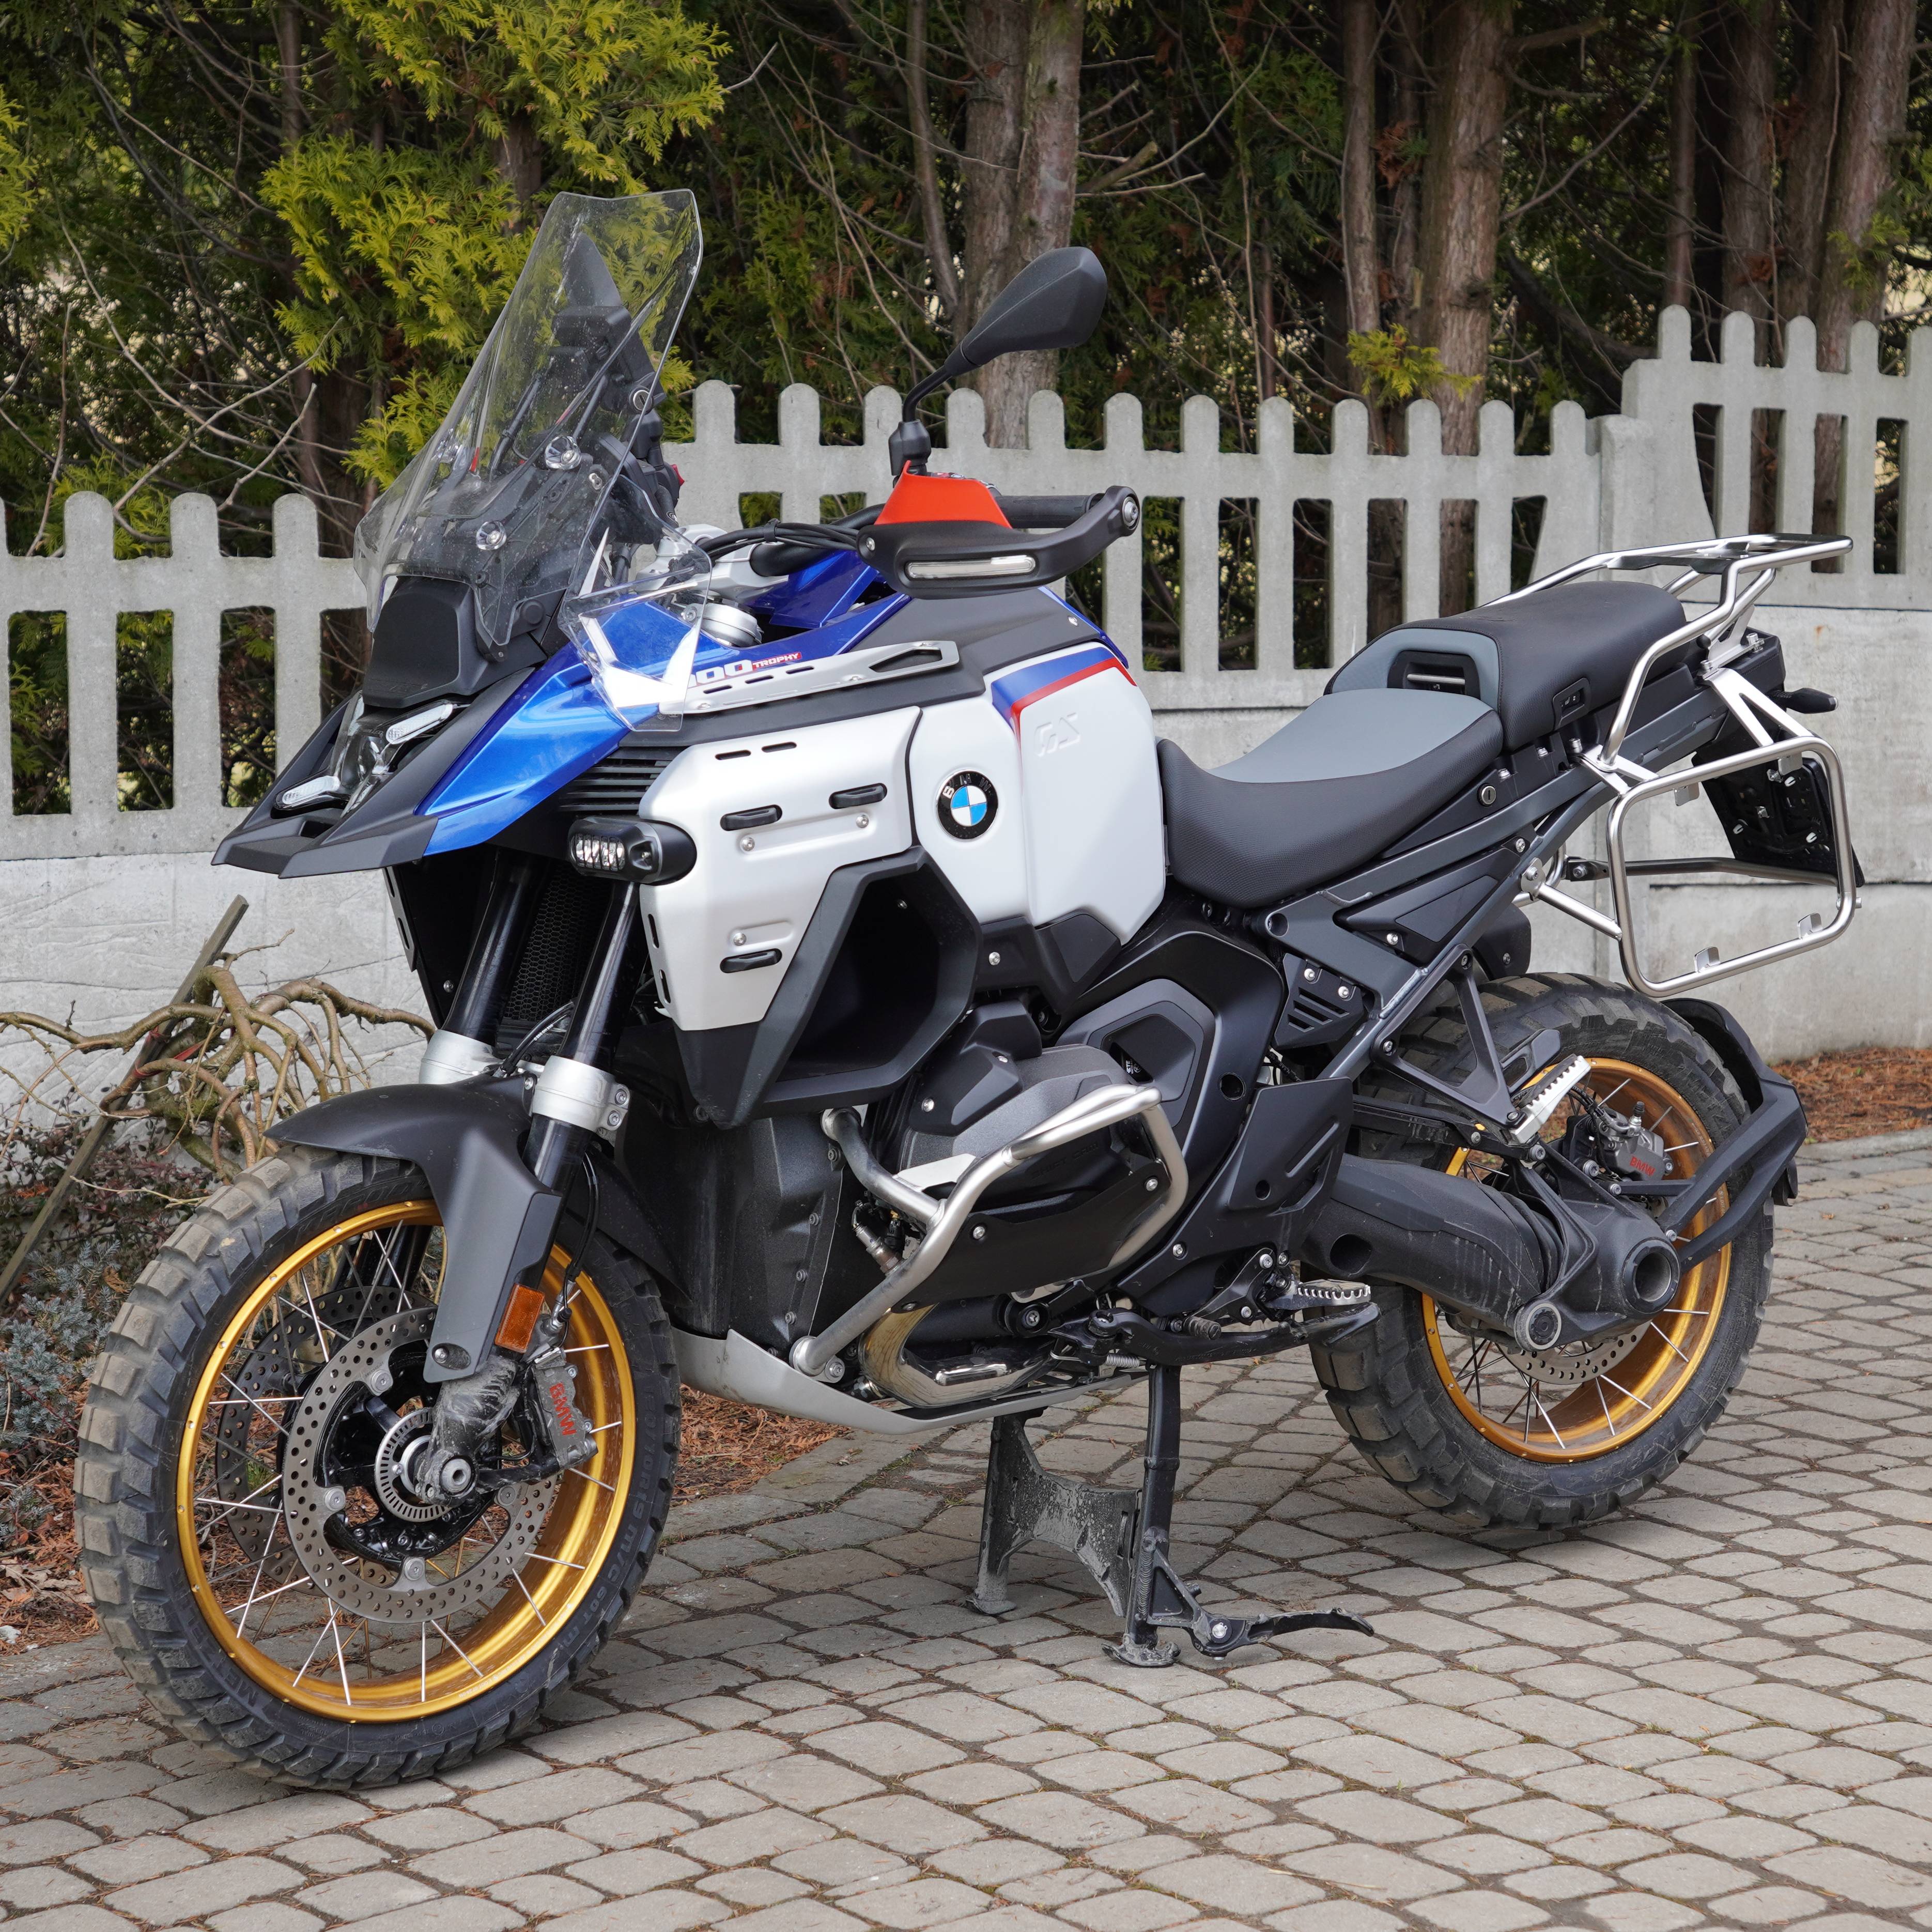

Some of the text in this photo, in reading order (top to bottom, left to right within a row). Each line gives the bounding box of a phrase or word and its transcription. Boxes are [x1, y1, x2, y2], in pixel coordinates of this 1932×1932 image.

[688, 653, 799, 688] 00 TROPHY
[942, 773, 992, 799] BMW
[1630, 1156, 1656, 1176] BMW
[549, 1382, 577, 1436] BMW
